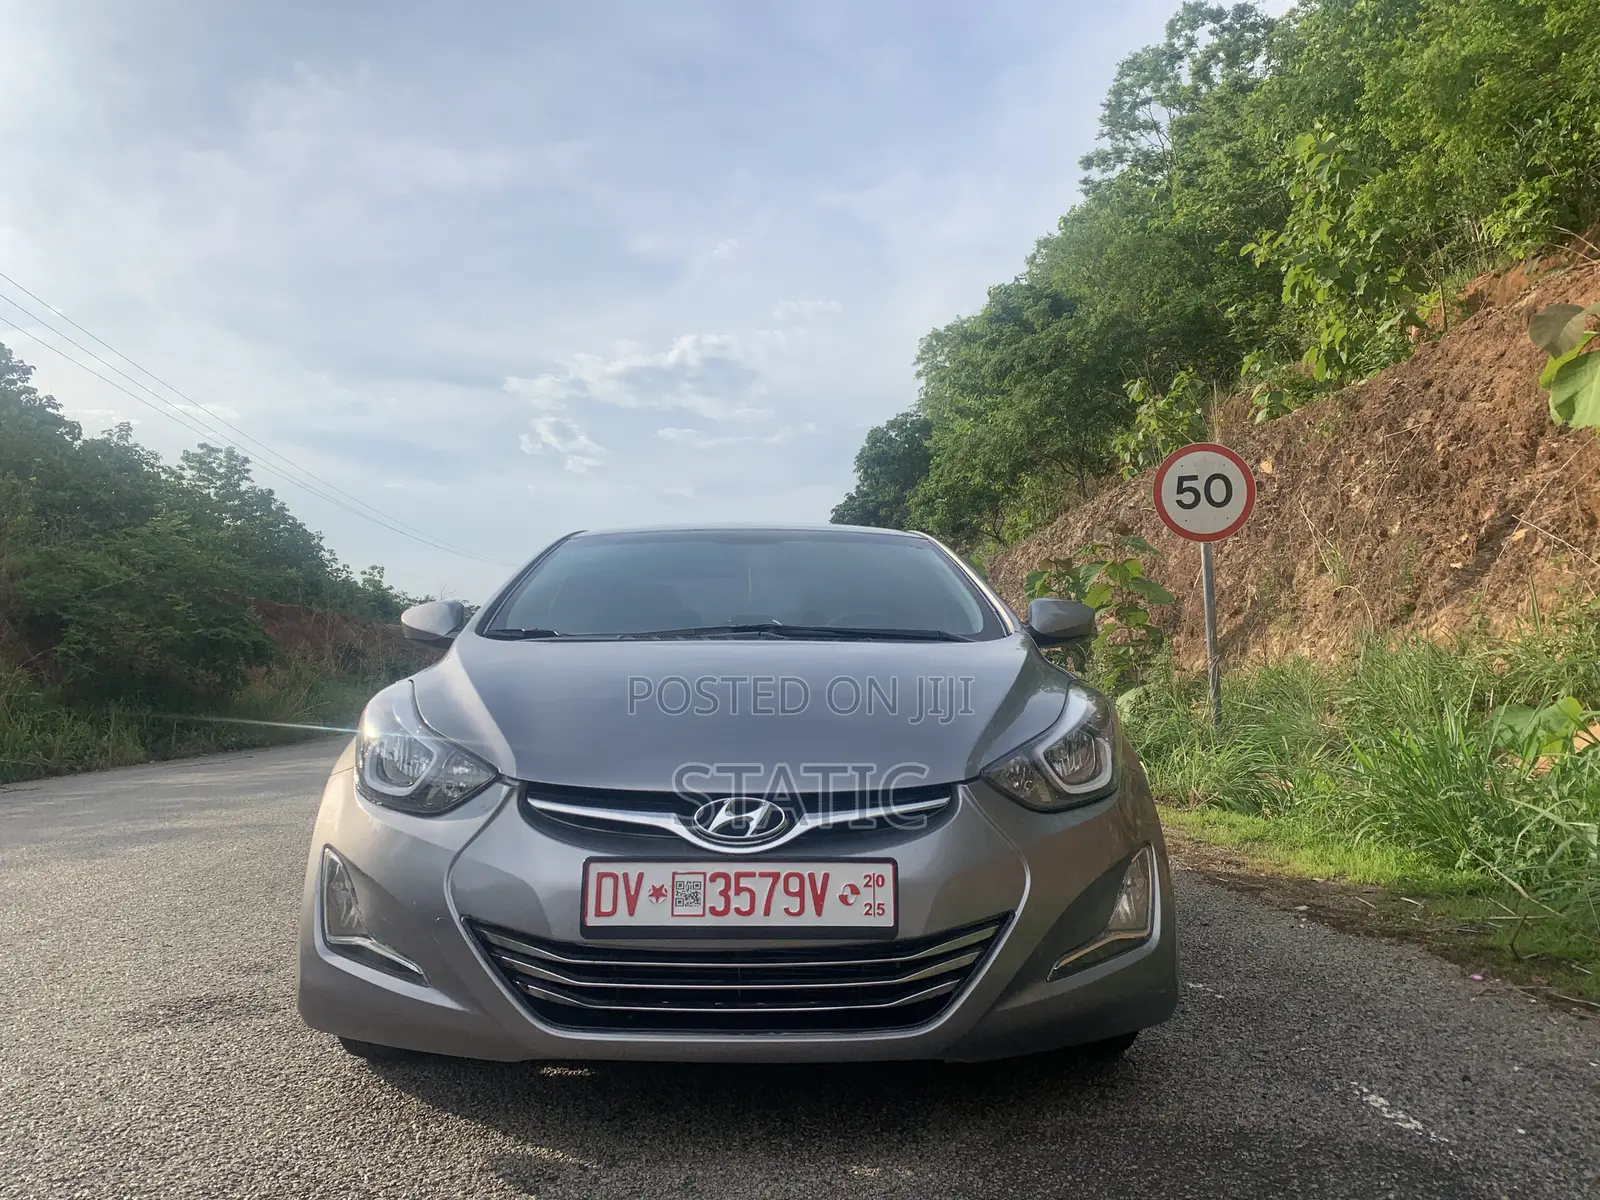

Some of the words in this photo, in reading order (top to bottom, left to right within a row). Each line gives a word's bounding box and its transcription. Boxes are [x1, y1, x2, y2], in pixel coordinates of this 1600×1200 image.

[1176, 473, 1233, 510] 50
[594, 871, 644, 917] DV
[708, 871, 830, 917] 3579V
